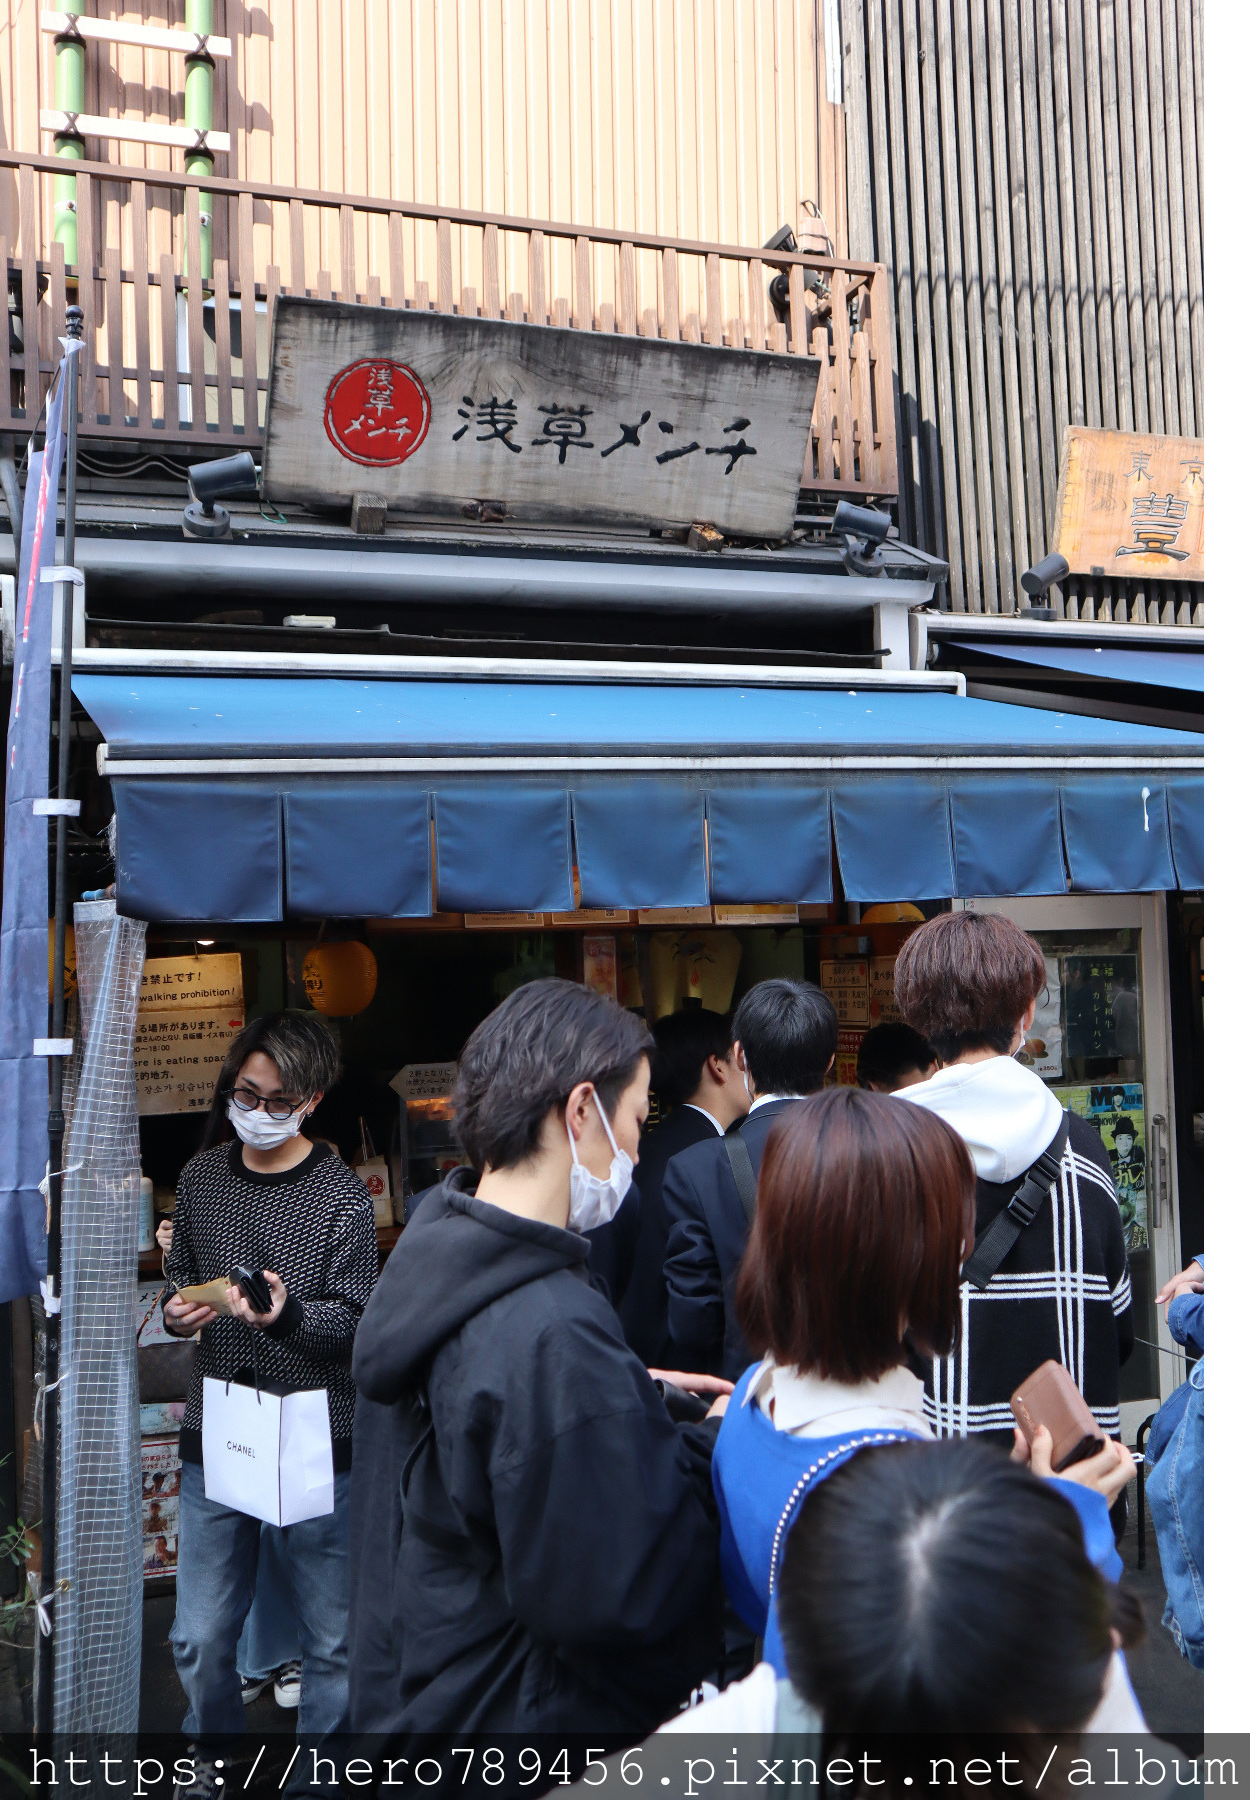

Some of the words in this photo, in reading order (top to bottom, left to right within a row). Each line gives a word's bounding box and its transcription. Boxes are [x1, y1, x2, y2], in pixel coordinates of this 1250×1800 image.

[366, 366, 395, 416] 浅草
[343, 411, 413, 443] メンチ
[451, 395, 758, 475] 浅草メンチ
[1122, 450, 1204, 486] 東京
[139, 992, 178, 1002] walking
[180, 987, 235, 1000] prohibition!
[135, 1020, 220, 1034] る場所があります。
[153, 1057, 162, 1066] is
[166, 1055, 199, 1066] eating
[226, 1440, 256, 1459] CHANEL
